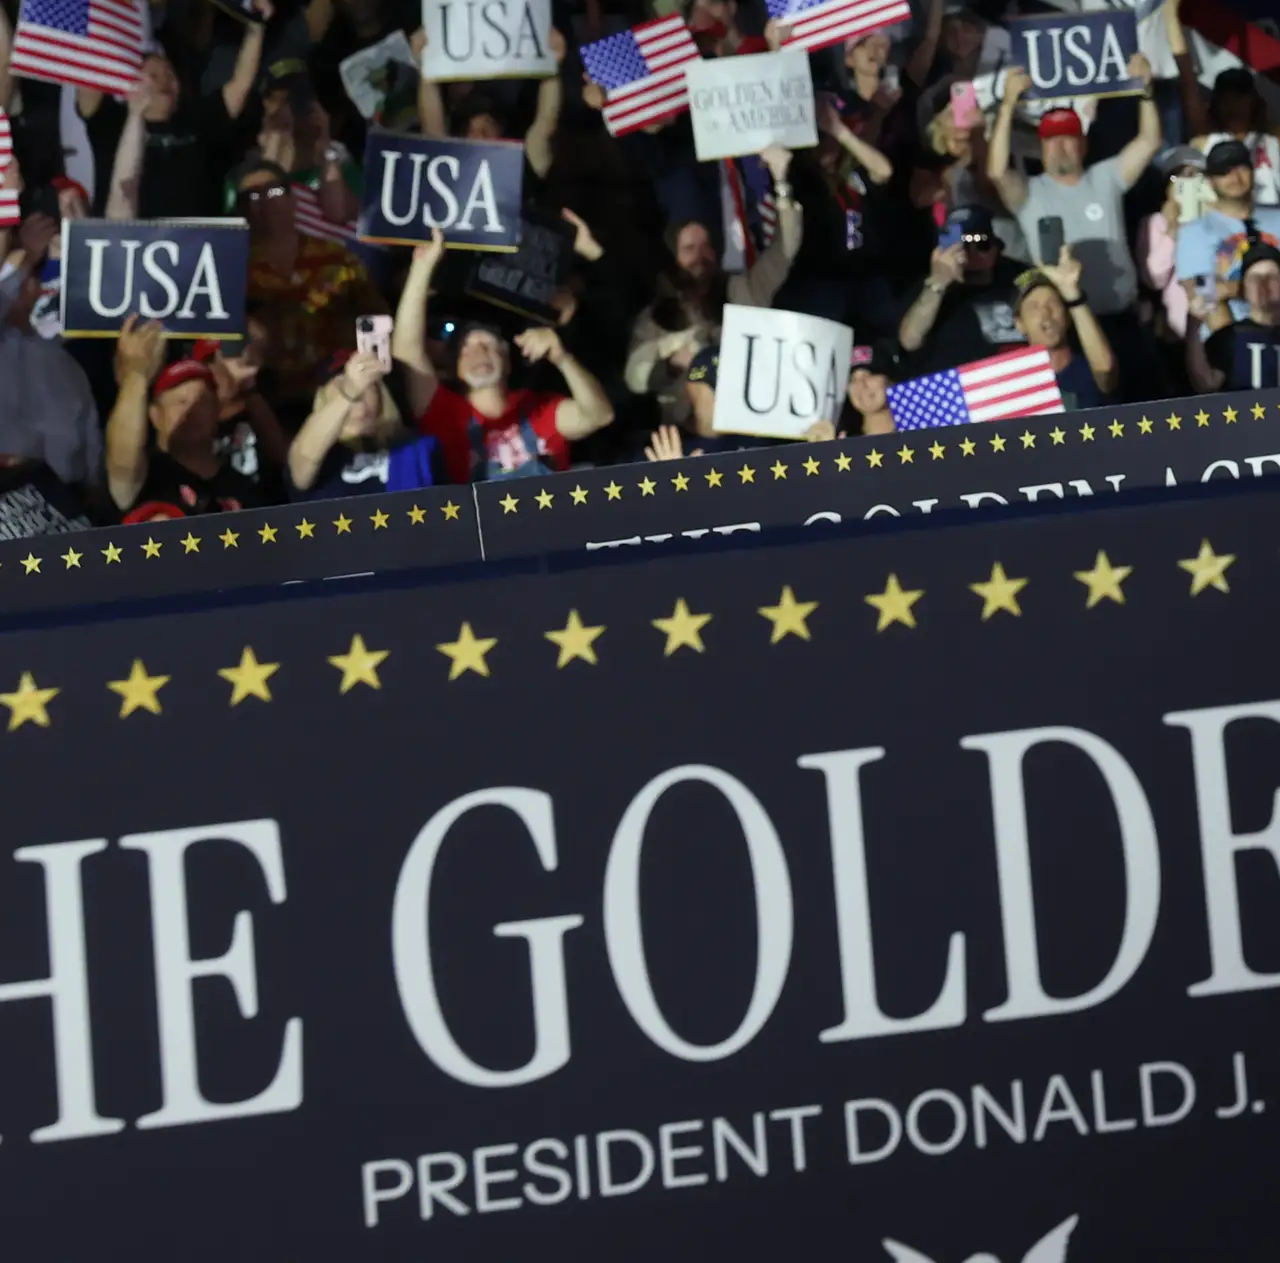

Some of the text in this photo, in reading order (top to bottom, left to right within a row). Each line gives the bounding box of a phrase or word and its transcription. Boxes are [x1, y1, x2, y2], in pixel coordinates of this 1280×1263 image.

[438, 0, 548, 62] USA
[1022, 22, 1131, 90] USA
[379, 149, 507, 234] USA
[84, 238, 230, 320] USA
[742, 333, 839, 424] USA
[0, 817, 304, 1143] HE
[362, 1104, 823, 1227] PRESIDENT
[846, 1060, 1197, 1166] DONALD
[1216, 1051, 1266, 1118] J.
